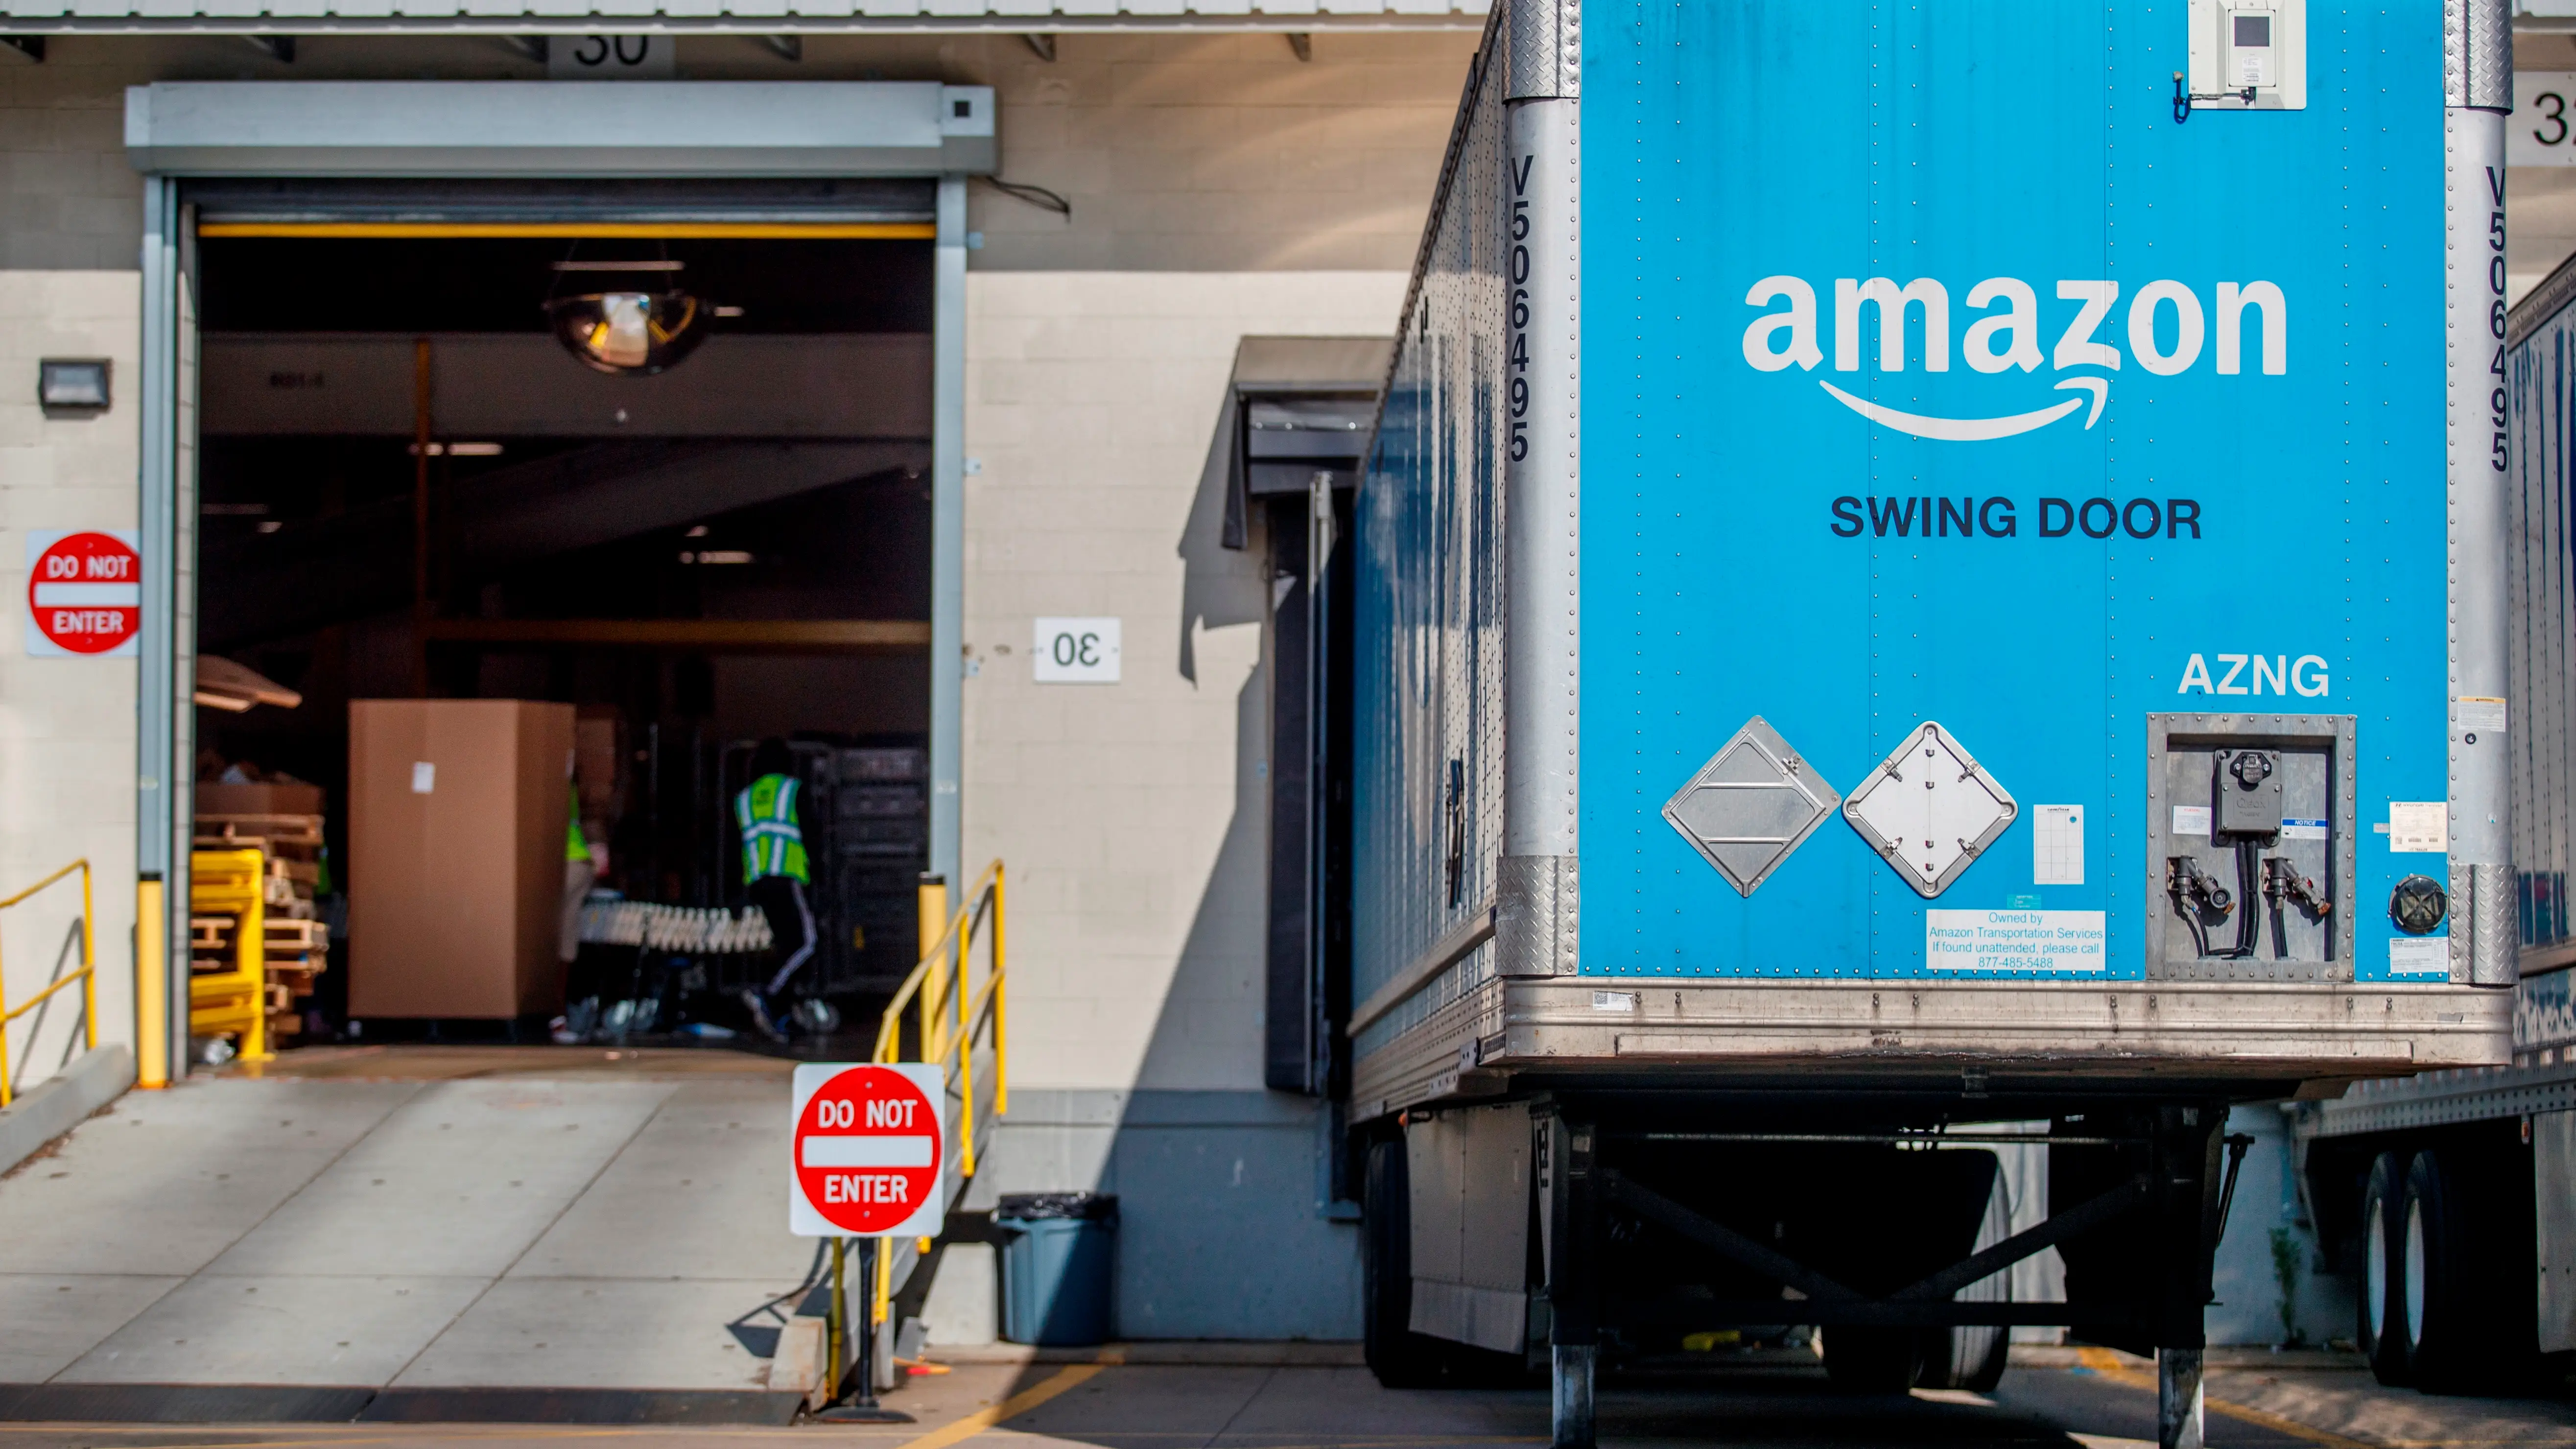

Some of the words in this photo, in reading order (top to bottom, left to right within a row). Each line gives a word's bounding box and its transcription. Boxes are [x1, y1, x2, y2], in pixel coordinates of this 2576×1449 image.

[2533, 92, 2576, 146] 3
[1511, 155, 1534, 462] V506495
[2485, 166, 2507, 473] V506495
[1742, 275, 2287, 376] amazon
[1830, 496, 2016, 539] SWING
[2038, 497, 2202, 540] DOOR
[46, 555, 79, 579] DO
[86, 555, 131, 579] NOT
[52, 610, 124, 634] ENTER
[2177, 653, 2329, 697] AZNG
[1929, 927, 1974, 938] Amazon
[1977, 927, 2054, 941] Transportation
[2057, 927, 2103, 939] Services
[1988, 912, 2027, 924] Owned
[2031, 913, 2043, 926] by
[1933, 941, 1939, 952] If
[1942, 941, 1972, 952] found
[1976, 942, 2038, 954] unattended,
[2043, 943, 2078, 956] please
[2081, 943, 2100, 954] call
[1978, 957, 2053, 969] 877-485-5488
[818, 1099, 855, 1129] DO
[866, 1099, 918, 1129] NOT
[824, 1174, 908, 1204] ENTER
